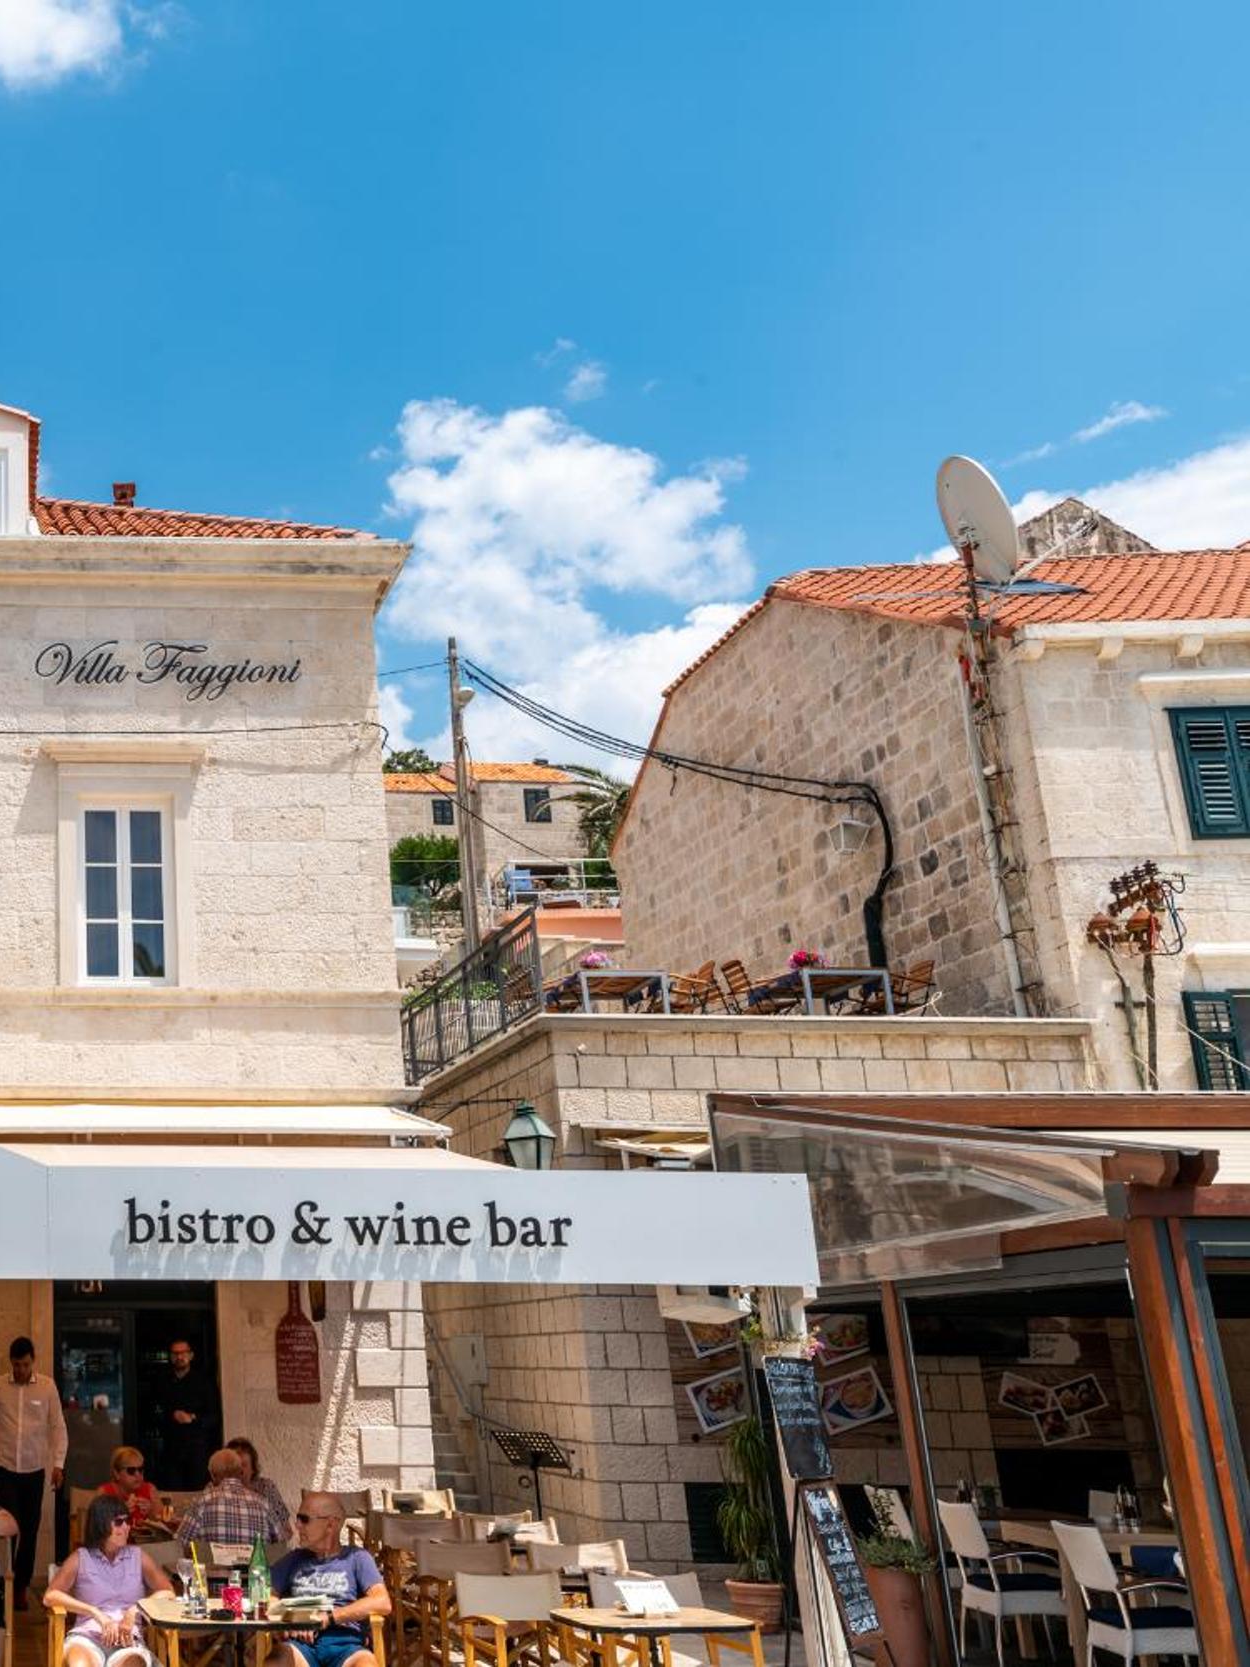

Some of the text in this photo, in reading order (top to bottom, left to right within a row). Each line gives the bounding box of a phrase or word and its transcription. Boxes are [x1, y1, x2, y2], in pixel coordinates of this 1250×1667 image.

[35, 640, 302, 701] Villa Faggioni
[124, 1197, 573, 1248] bistro & wine bar
